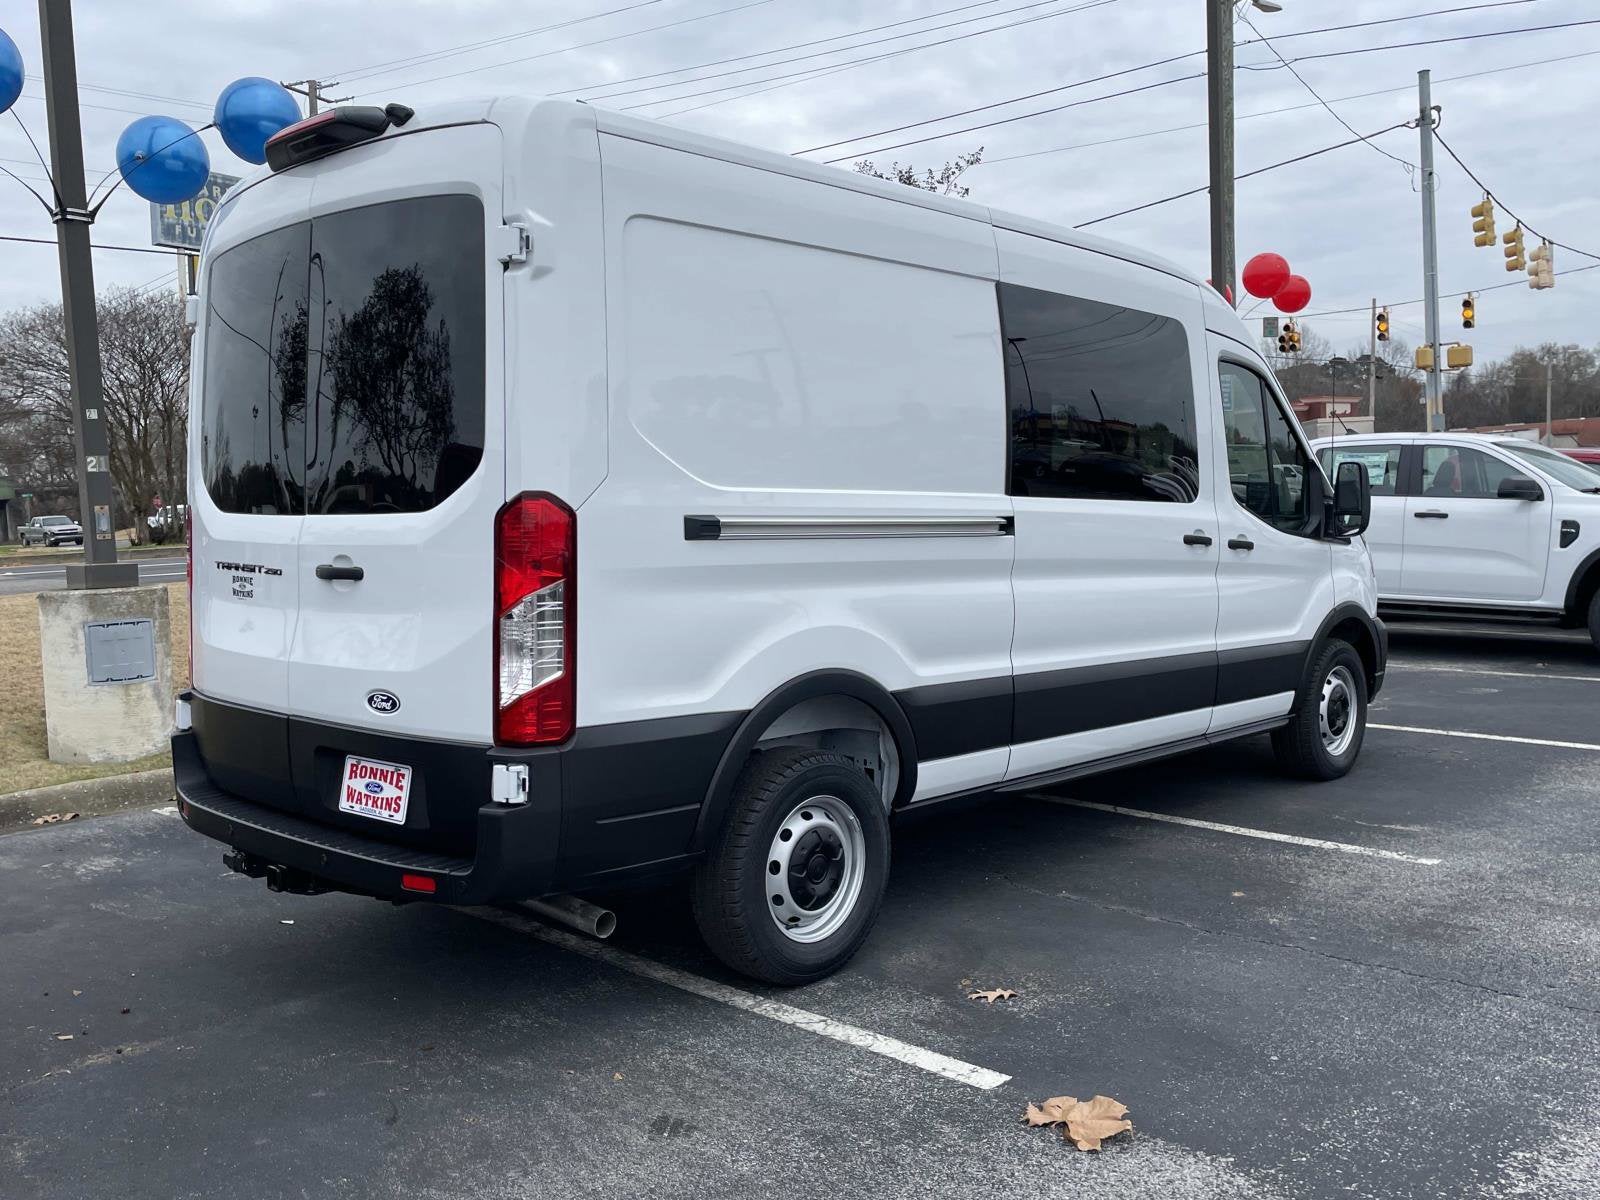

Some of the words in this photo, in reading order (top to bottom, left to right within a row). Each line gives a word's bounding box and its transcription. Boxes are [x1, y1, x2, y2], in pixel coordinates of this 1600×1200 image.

[214, 561, 264, 574] TRANSIT
[232, 575, 253, 586] RONNIE
[232, 587, 253, 599] WATKINS
[371, 694, 393, 710] Ford
[348, 762, 405, 793] RONNIE
[346, 784, 402, 814] WATKINS
